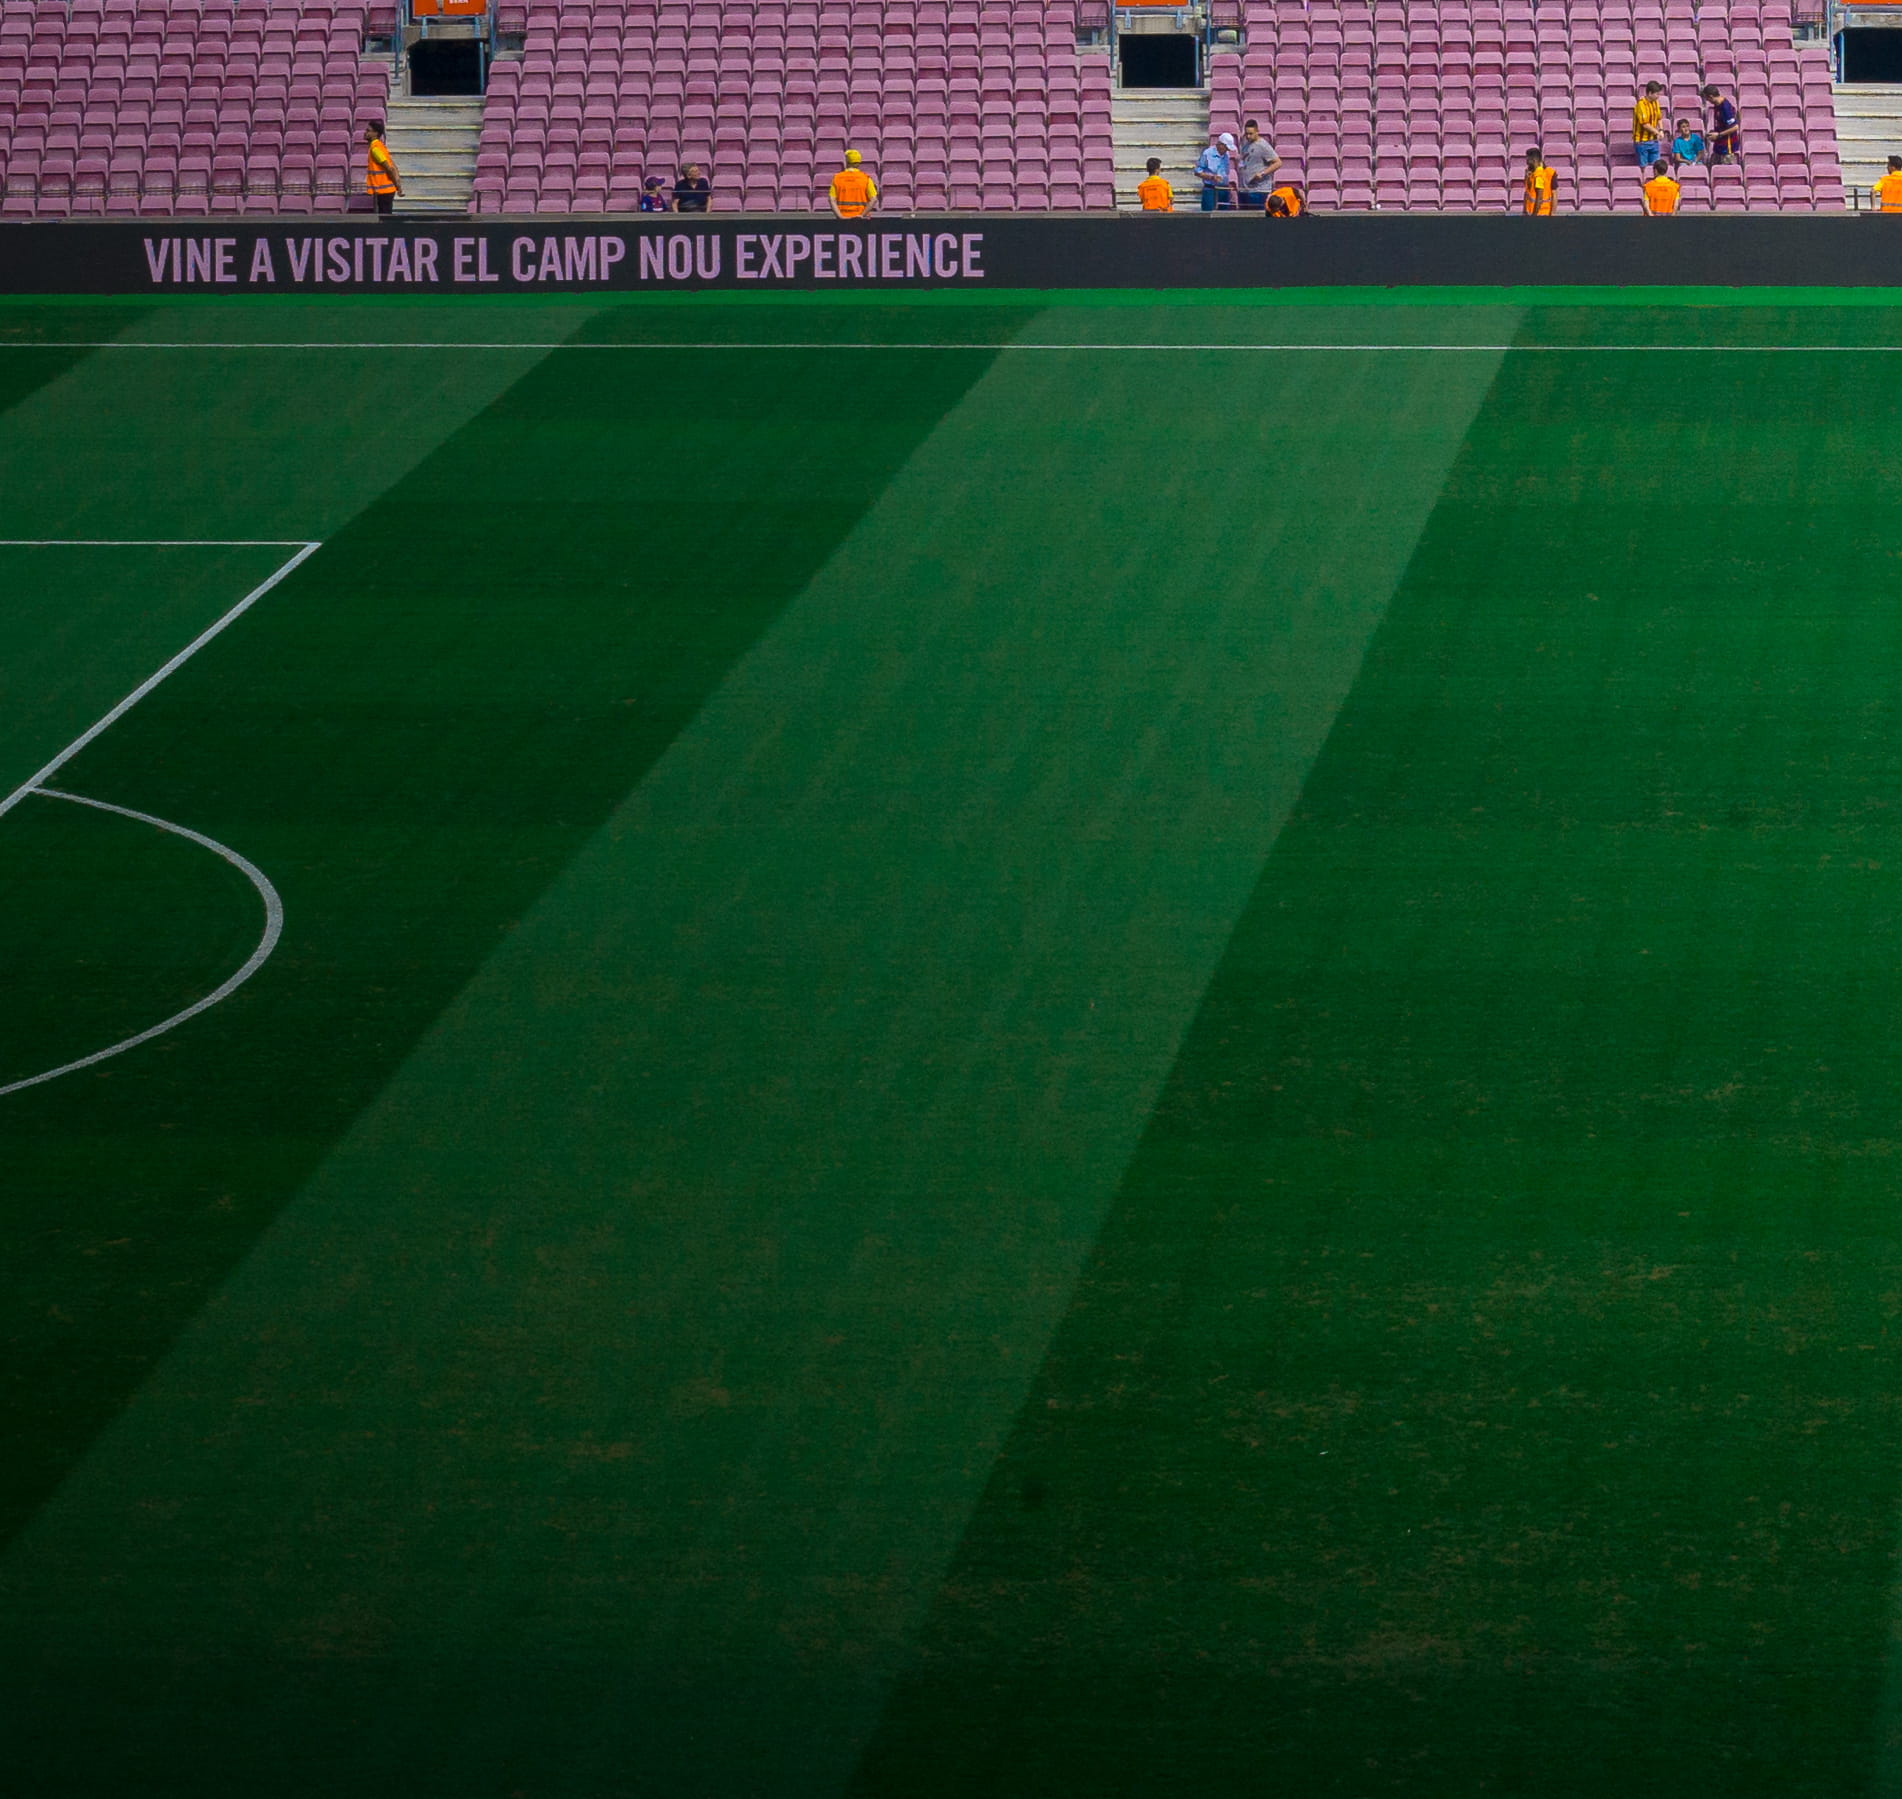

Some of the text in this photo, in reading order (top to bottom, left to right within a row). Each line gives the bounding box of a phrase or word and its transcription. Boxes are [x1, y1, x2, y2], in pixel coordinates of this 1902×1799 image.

[143, 233, 985, 283] VINE A VISITAR EL CAMP NOU EXPERIENCE
